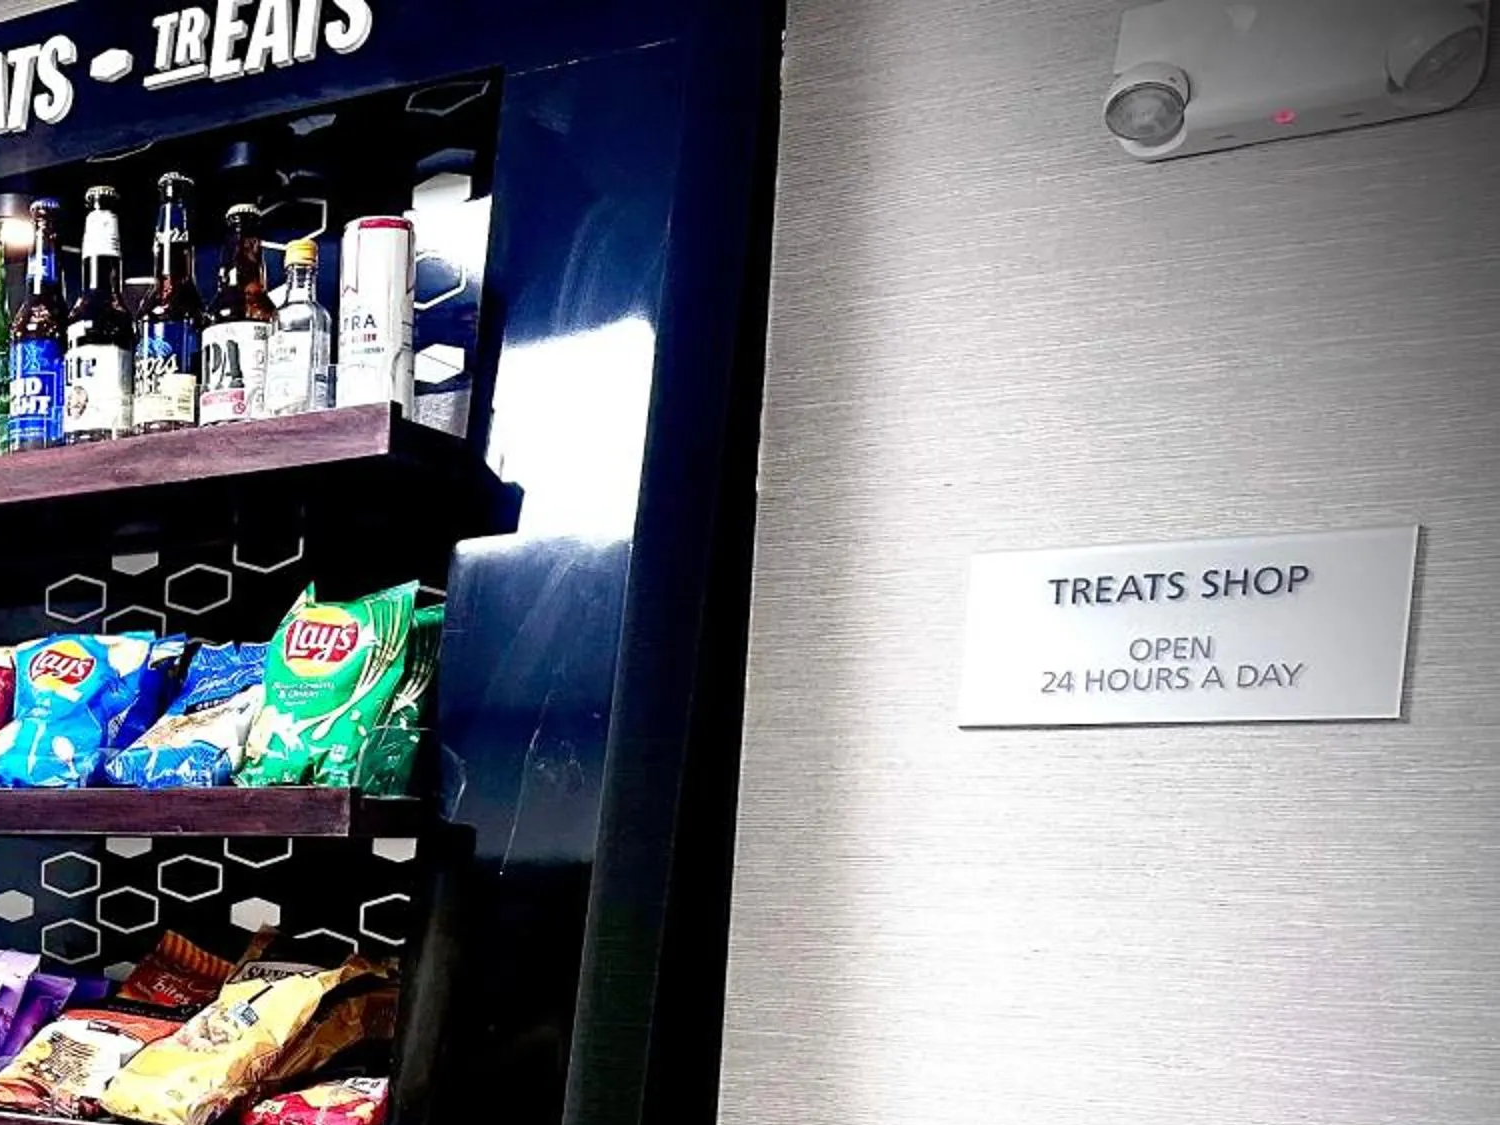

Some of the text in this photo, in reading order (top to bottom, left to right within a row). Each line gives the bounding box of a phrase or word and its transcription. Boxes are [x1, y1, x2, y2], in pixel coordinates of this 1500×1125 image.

[143, 0, 373, 90] TREATS
[1048, 564, 1312, 606] TREATS SHOP
[1129, 635, 1214, 662] OPEN
[1040, 662, 1306, 695] 24 HOURS A DAY
